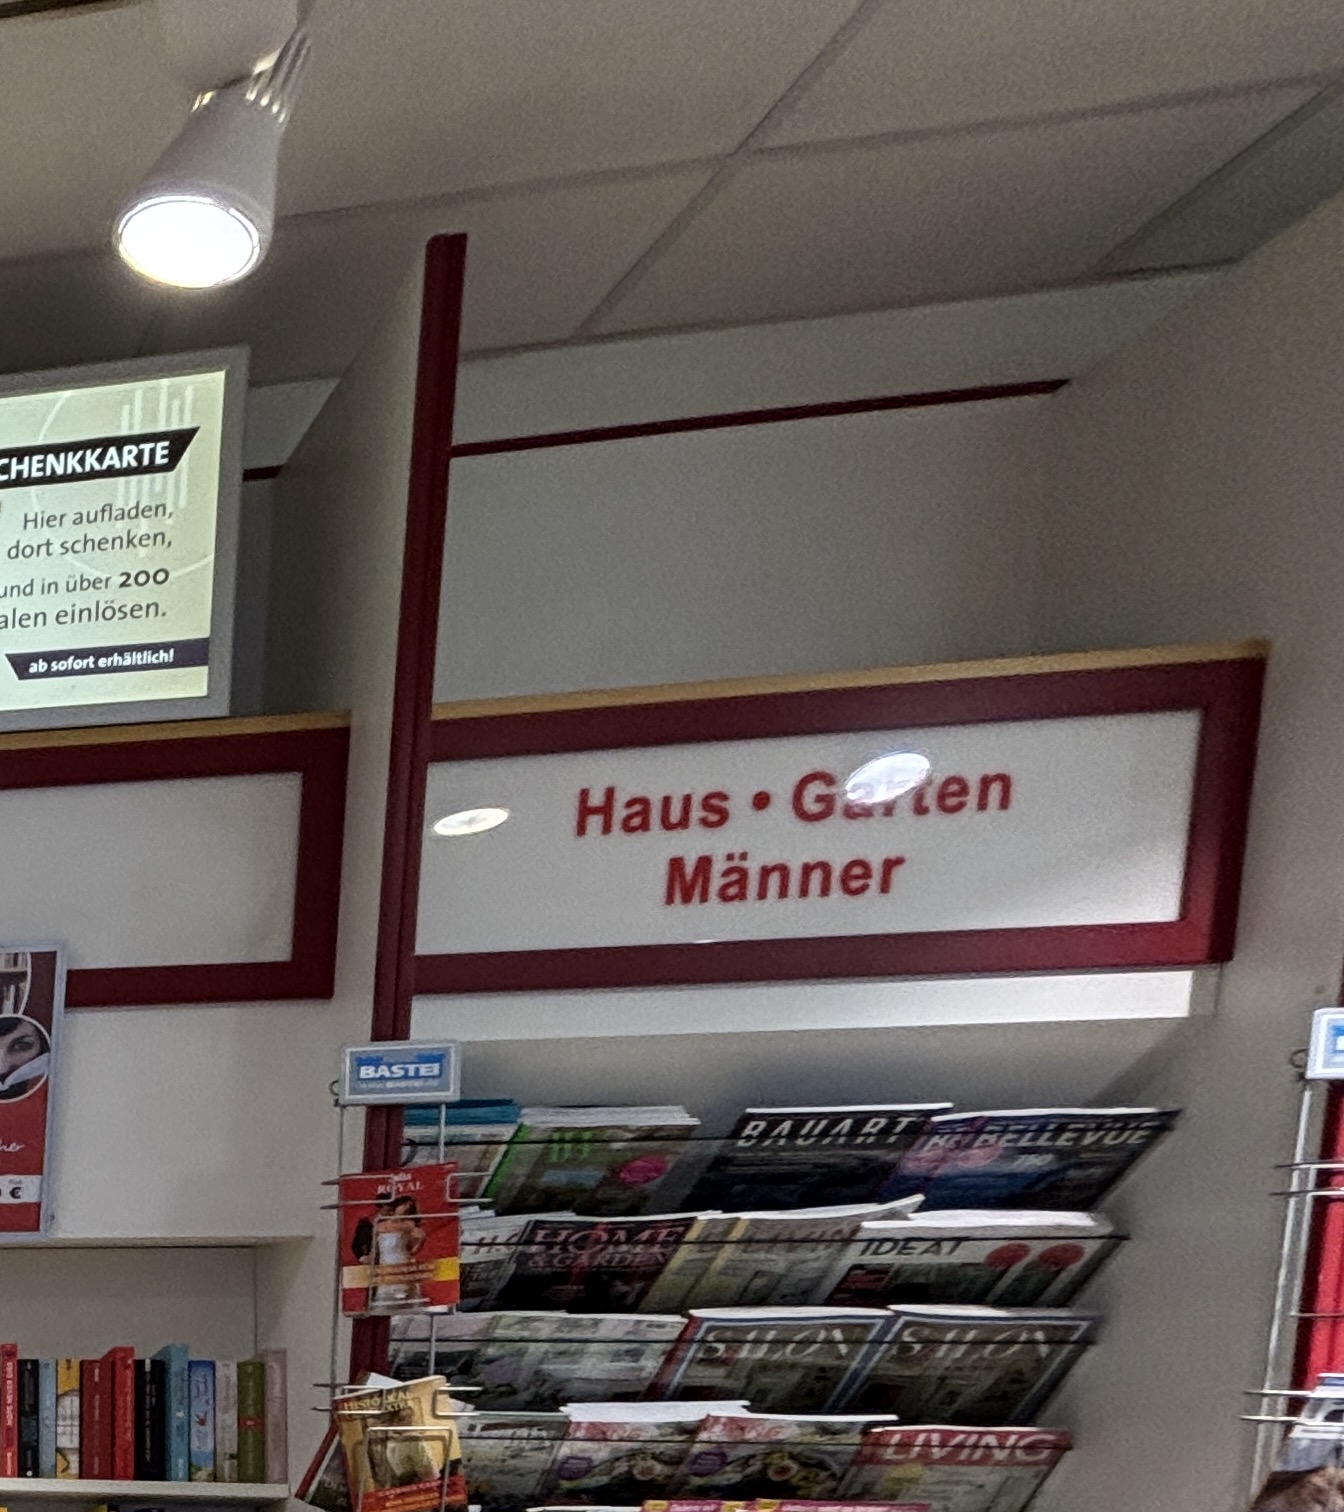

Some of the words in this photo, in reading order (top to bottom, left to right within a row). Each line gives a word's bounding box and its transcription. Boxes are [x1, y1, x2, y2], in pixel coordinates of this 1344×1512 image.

[23, 510, 65, 532] Hier
[72, 501, 174, 527] aufladen,
[7, 538, 53, 560] dort
[59, 530, 173, 555] schenken,
[41, 578, 59, 596] in
[65, 572, 112, 593] über
[118, 568, 170, 589] 200
[55, 599, 168, 627] einlösen.
[28, 659, 47, 674] ab
[50, 654, 95, 673] sofort
[98, 648, 175, 669] erhältlich!
[575, 784, 730, 838] Haus
[792, 770, 1012, 822] Gten
[664, 851, 906, 906] Männer
[359, 1060, 442, 1083] BASTEI
[9, 1185, 22, 1200] €
[883, 1433, 1054, 1462] LIVING
